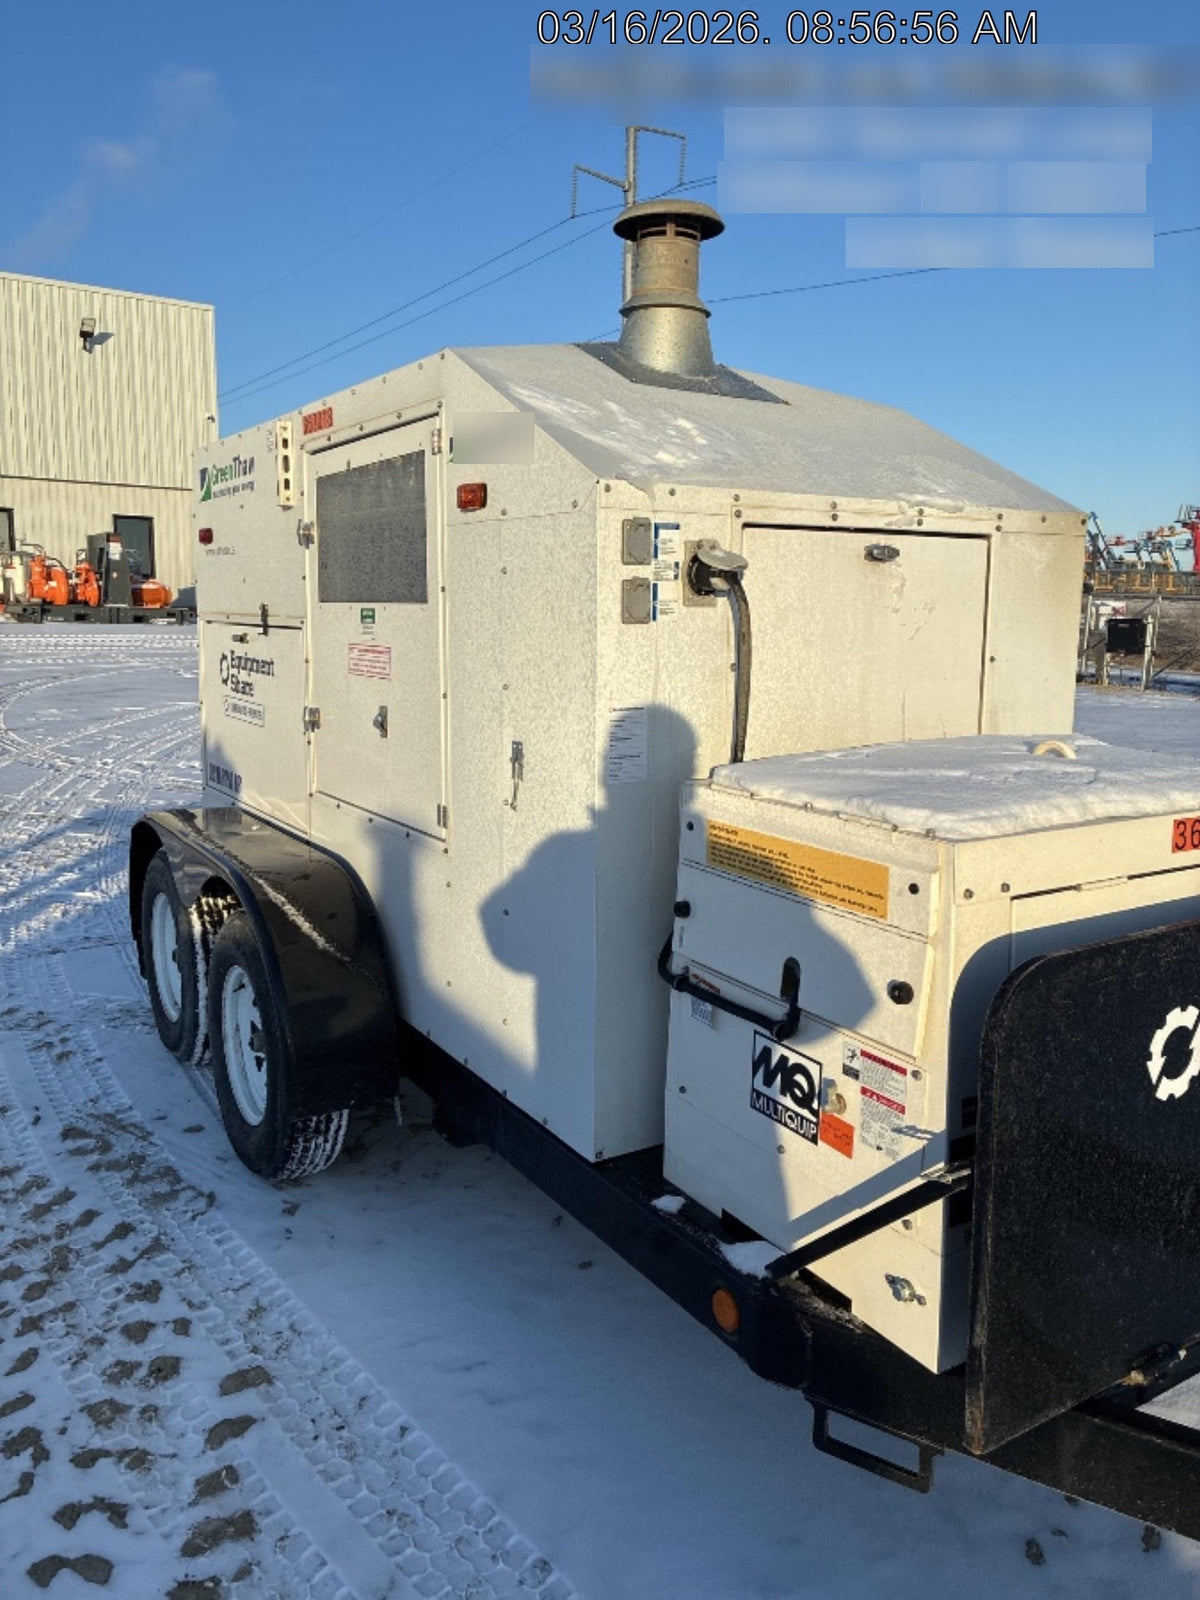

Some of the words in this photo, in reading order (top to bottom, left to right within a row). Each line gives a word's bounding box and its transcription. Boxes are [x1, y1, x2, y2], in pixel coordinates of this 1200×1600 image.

[230, 650, 275, 677] Equipment
[230, 673, 254, 697] Share
[1175, 819, 1200, 850] 36
[753, 1044, 819, 1120] MQ
[752, 1091, 817, 1139] MULTIQUIP
